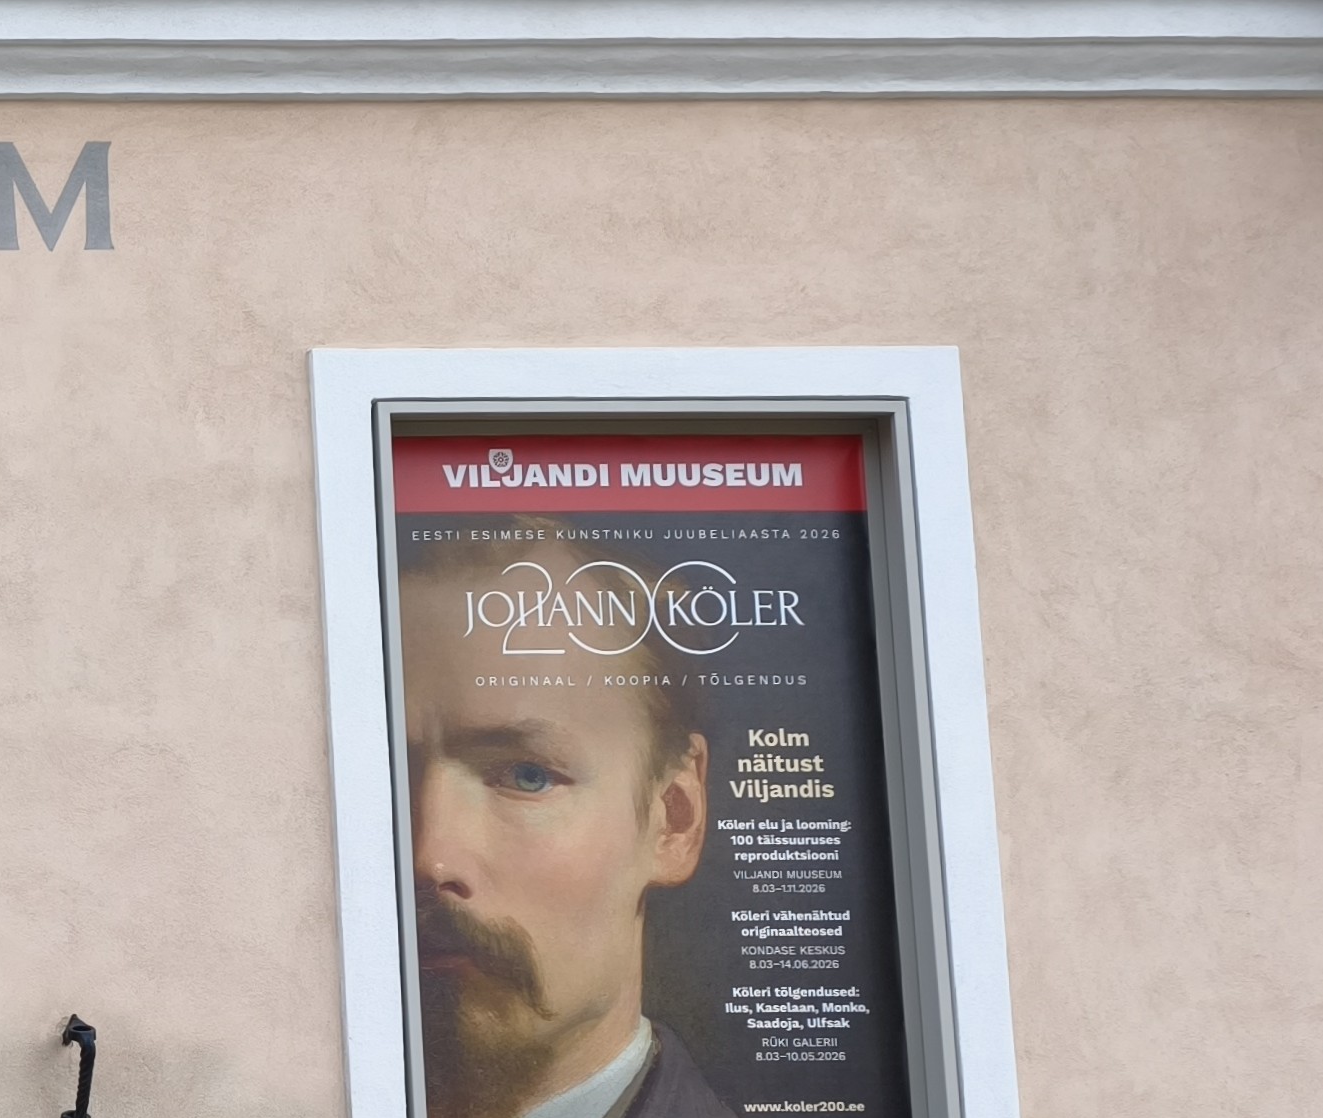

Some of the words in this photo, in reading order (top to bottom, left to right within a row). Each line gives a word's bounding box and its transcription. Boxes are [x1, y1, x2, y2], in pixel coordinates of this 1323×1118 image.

[442, 462, 610, 488] VILJANDI
[620, 462, 803, 488] MUUSEUM
[412, 529, 460, 541] EESTI
[470, 529, 546, 540] ESIMESE
[556, 529, 654, 540] KUNSTNIKU
[664, 529, 791, 540] JUUBELIAASTA
[800, 528, 841, 539] 2026
[463, 590, 636, 638] JOHANN
[667, 585, 805, 627] KÖLER
[475, 675, 576, 687] ORIGINAAL
[604, 675, 672, 686] KOOPIA
[699, 671, 808, 686] TÕLGENDUS
[748, 728, 810, 747] Kolm
[737, 754, 825, 772] näitust
[729, 779, 835, 802] Viljandis
[717, 819, 755, 830] Köleri
[758, 819, 778, 830] elu
[780, 819, 794, 832] ja
[796, 819, 852, 832] looming:
[730, 835, 753, 845] 100
[757, 834, 841, 845] täissuuruses
[734, 850, 839, 863] reproduktsiooni
[733, 870, 782, 879] VILJANDI
[787, 870, 842, 879] MUUSEUM
[731, 910, 770, 921] Köleri
[773, 910, 851, 921] vähenähtud
[741, 926, 843, 939] originaalteosed
[741, 946, 796, 955] KONDASE
[800, 946, 846, 955] KESKUS
[732, 986, 771, 997] Köleri
[775, 986, 860, 1000] tõlgendused:
[725, 1002, 753, 1014] Ilus,
[756, 1002, 819, 1015] Kaselaan,
[822, 1002, 870, 1014] Monko,
[747, 1018, 804, 1031] Saadoja,
[807, 1018, 850, 1028] Ulfsak
[793, 1037, 838, 1047] GALERII
[744, 1101, 865, 1112] www.koler200.ee
